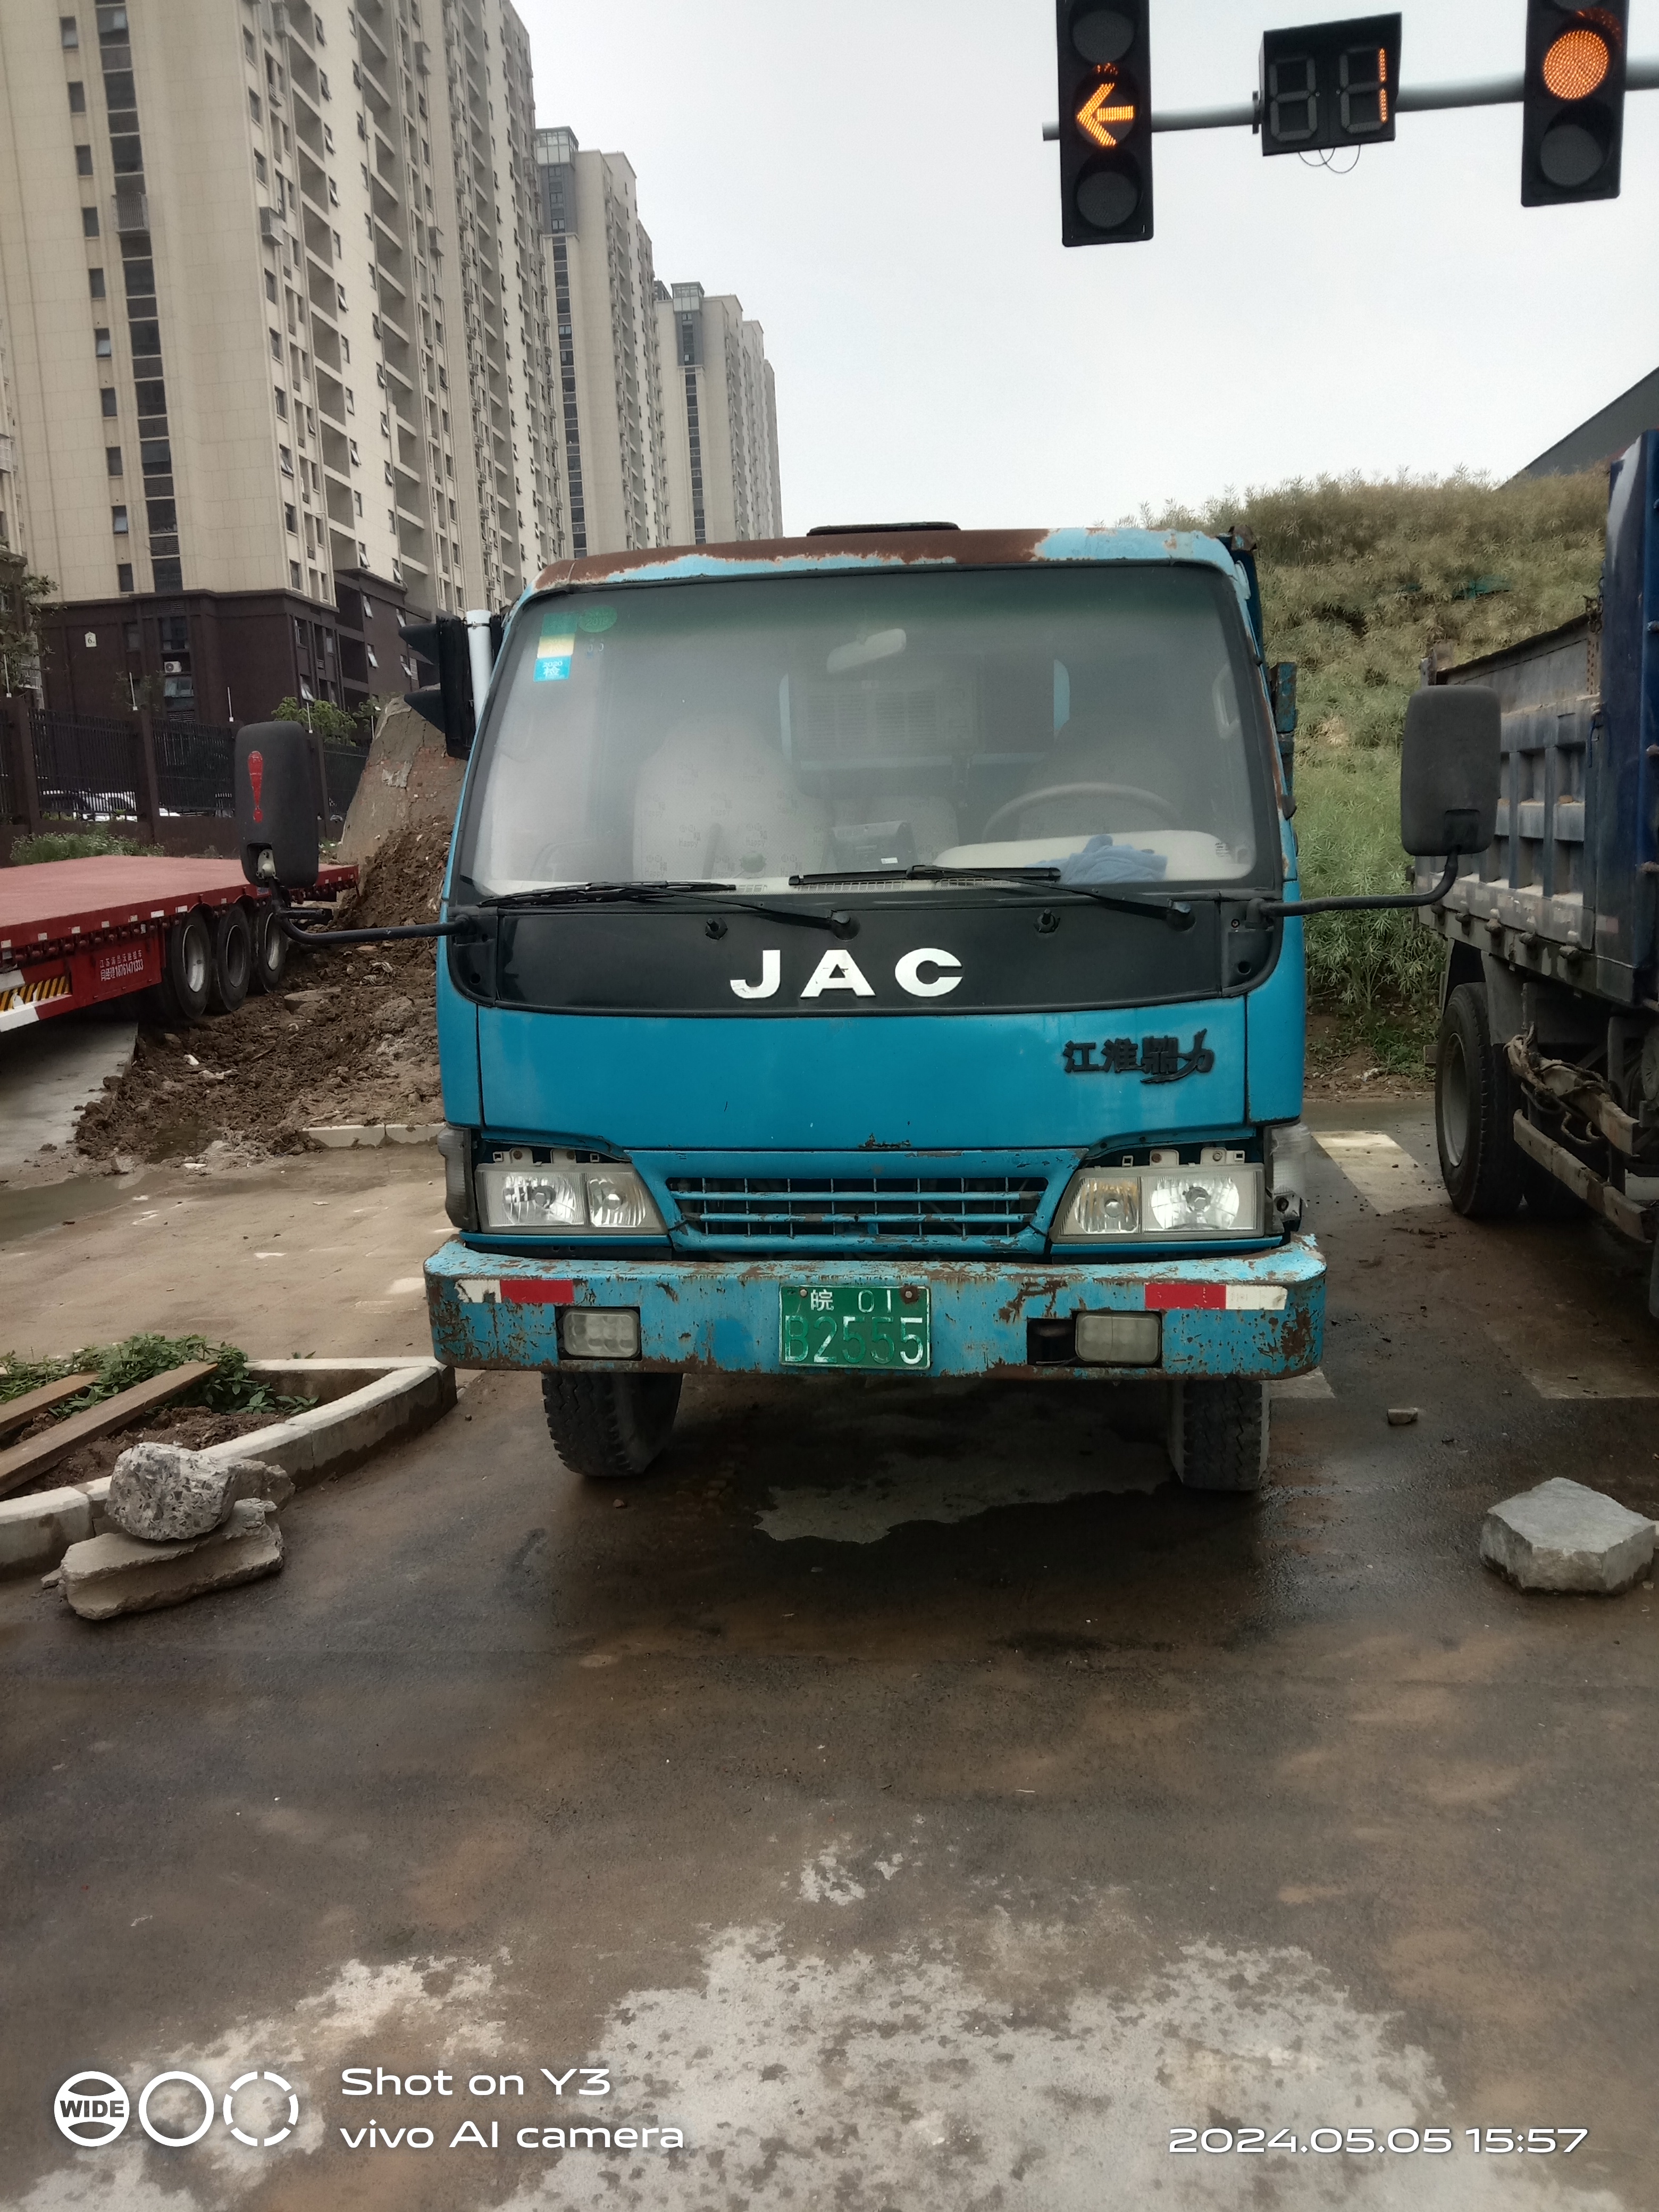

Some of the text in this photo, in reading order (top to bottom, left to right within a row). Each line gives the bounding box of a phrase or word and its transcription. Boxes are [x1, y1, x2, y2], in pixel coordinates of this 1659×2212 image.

[730, 948, 963, 999] JAC
[810, 1289, 834, 1312] 皖
[784, 1314, 924, 1365] B2555
